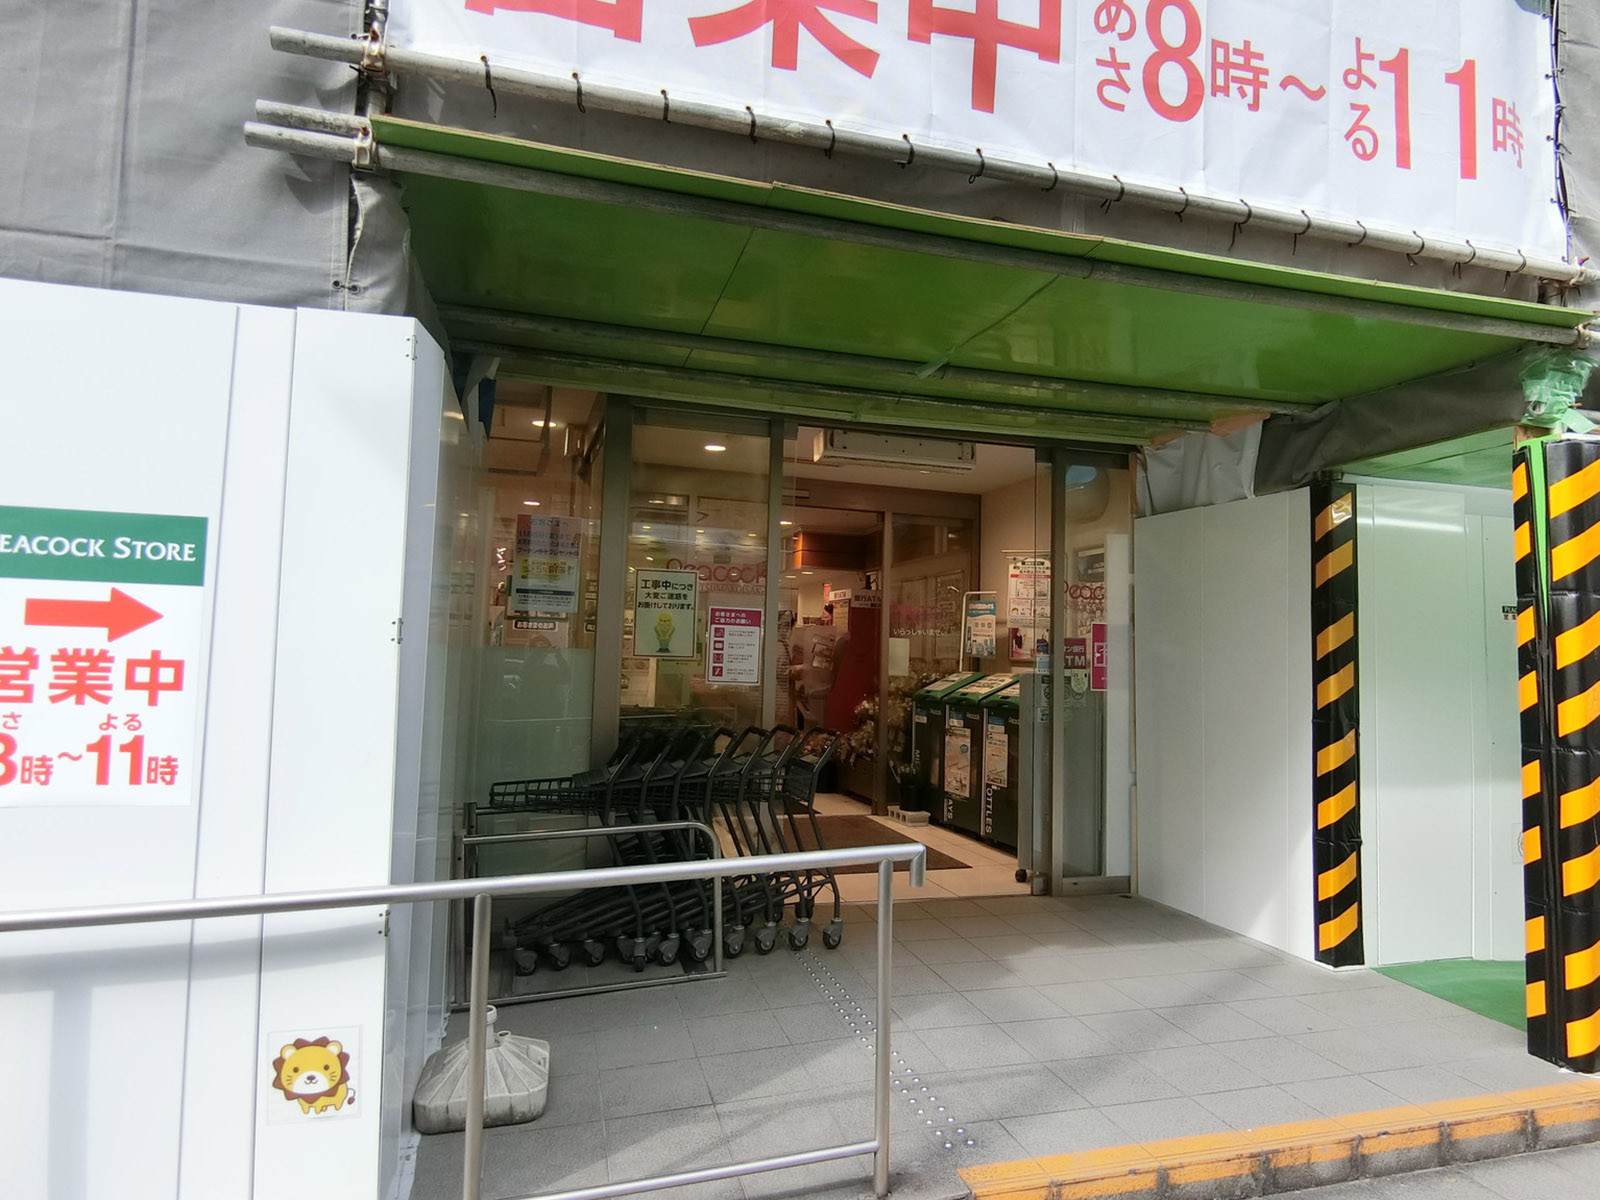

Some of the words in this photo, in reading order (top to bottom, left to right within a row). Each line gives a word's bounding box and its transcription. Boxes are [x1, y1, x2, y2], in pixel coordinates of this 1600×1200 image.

[113, 536, 196, 562] STORE
[641, 579, 694, 591] 工事中につき
[645, 592, 688, 600] 大変ご迷惑を
[98, 713, 142, 731] よる
